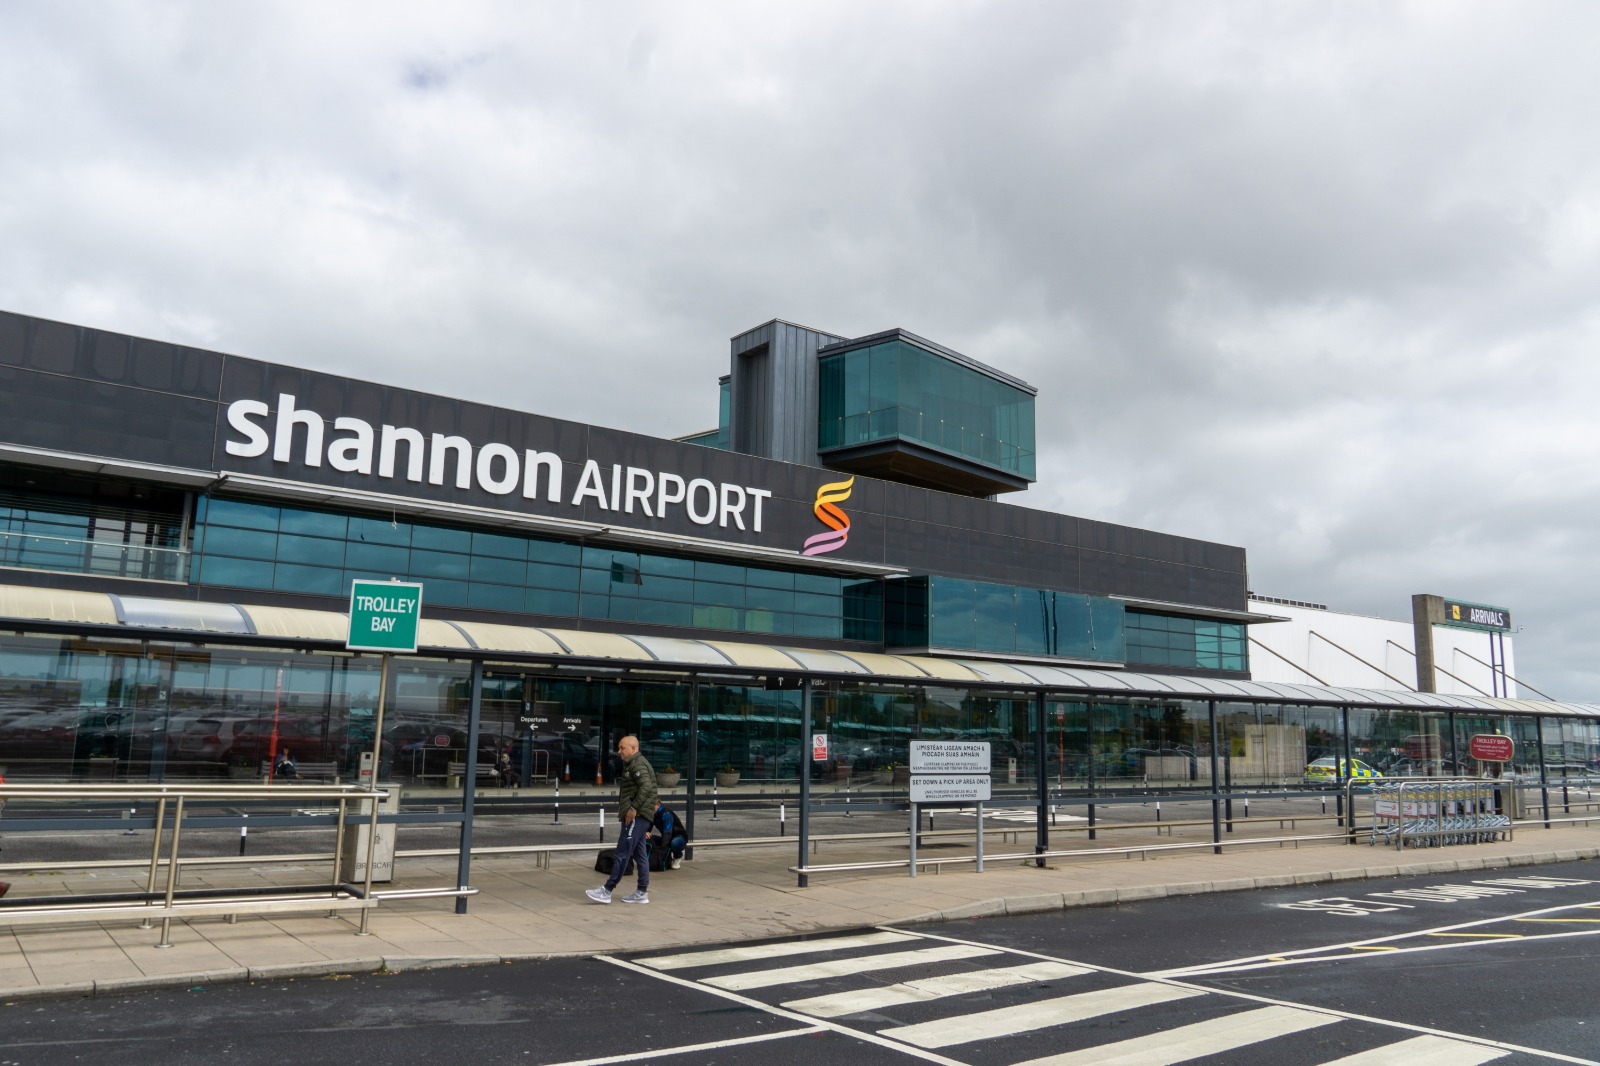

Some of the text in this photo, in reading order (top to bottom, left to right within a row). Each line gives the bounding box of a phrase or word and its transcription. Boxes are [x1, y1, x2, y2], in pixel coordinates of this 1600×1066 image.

[225, 393, 772, 533] shannon AIRPORT
[356, 595, 416, 614] TROLLEY
[370, 616, 397, 632] BAY
[1470, 608, 1504, 627] ARRIVALS
[355, 862, 392, 870] BRSCAR
[1276, 896, 1415, 916] SET
